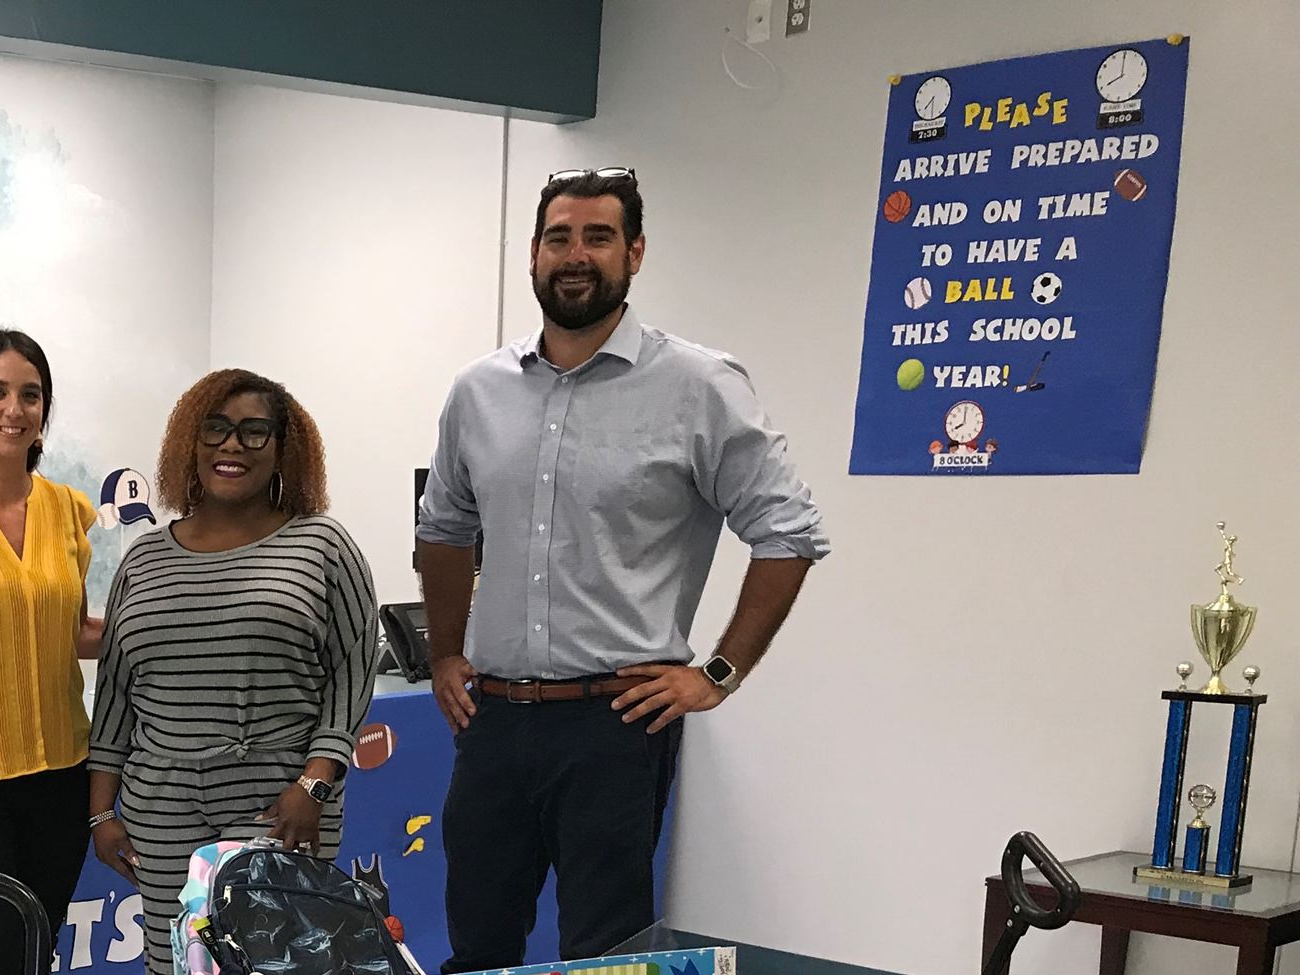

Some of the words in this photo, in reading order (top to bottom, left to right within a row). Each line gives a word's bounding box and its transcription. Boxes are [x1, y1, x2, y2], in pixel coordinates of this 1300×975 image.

[964, 92, 1068, 131] PLEASE
[1108, 113, 1132, 124] 8:00
[918, 128, 938, 139] 7:30
[893, 149, 992, 183] ARRIVE
[1011, 134, 1160, 170] PREPARED
[912, 202, 968, 228] AND
[983, 199, 1022, 224] ON
[1038, 191, 1111, 220] TIME
[922, 243, 953, 267] TO
[967, 237, 1042, 264] HAVE
[1055, 236, 1078, 261] A
[944, 276, 1015, 304] BALL
[891, 319, 949, 346] THIS
[969, 316, 1077, 342] SCHOOL
[933, 364, 1010, 388] YEAR!
[127, 479, 139, 499] B
